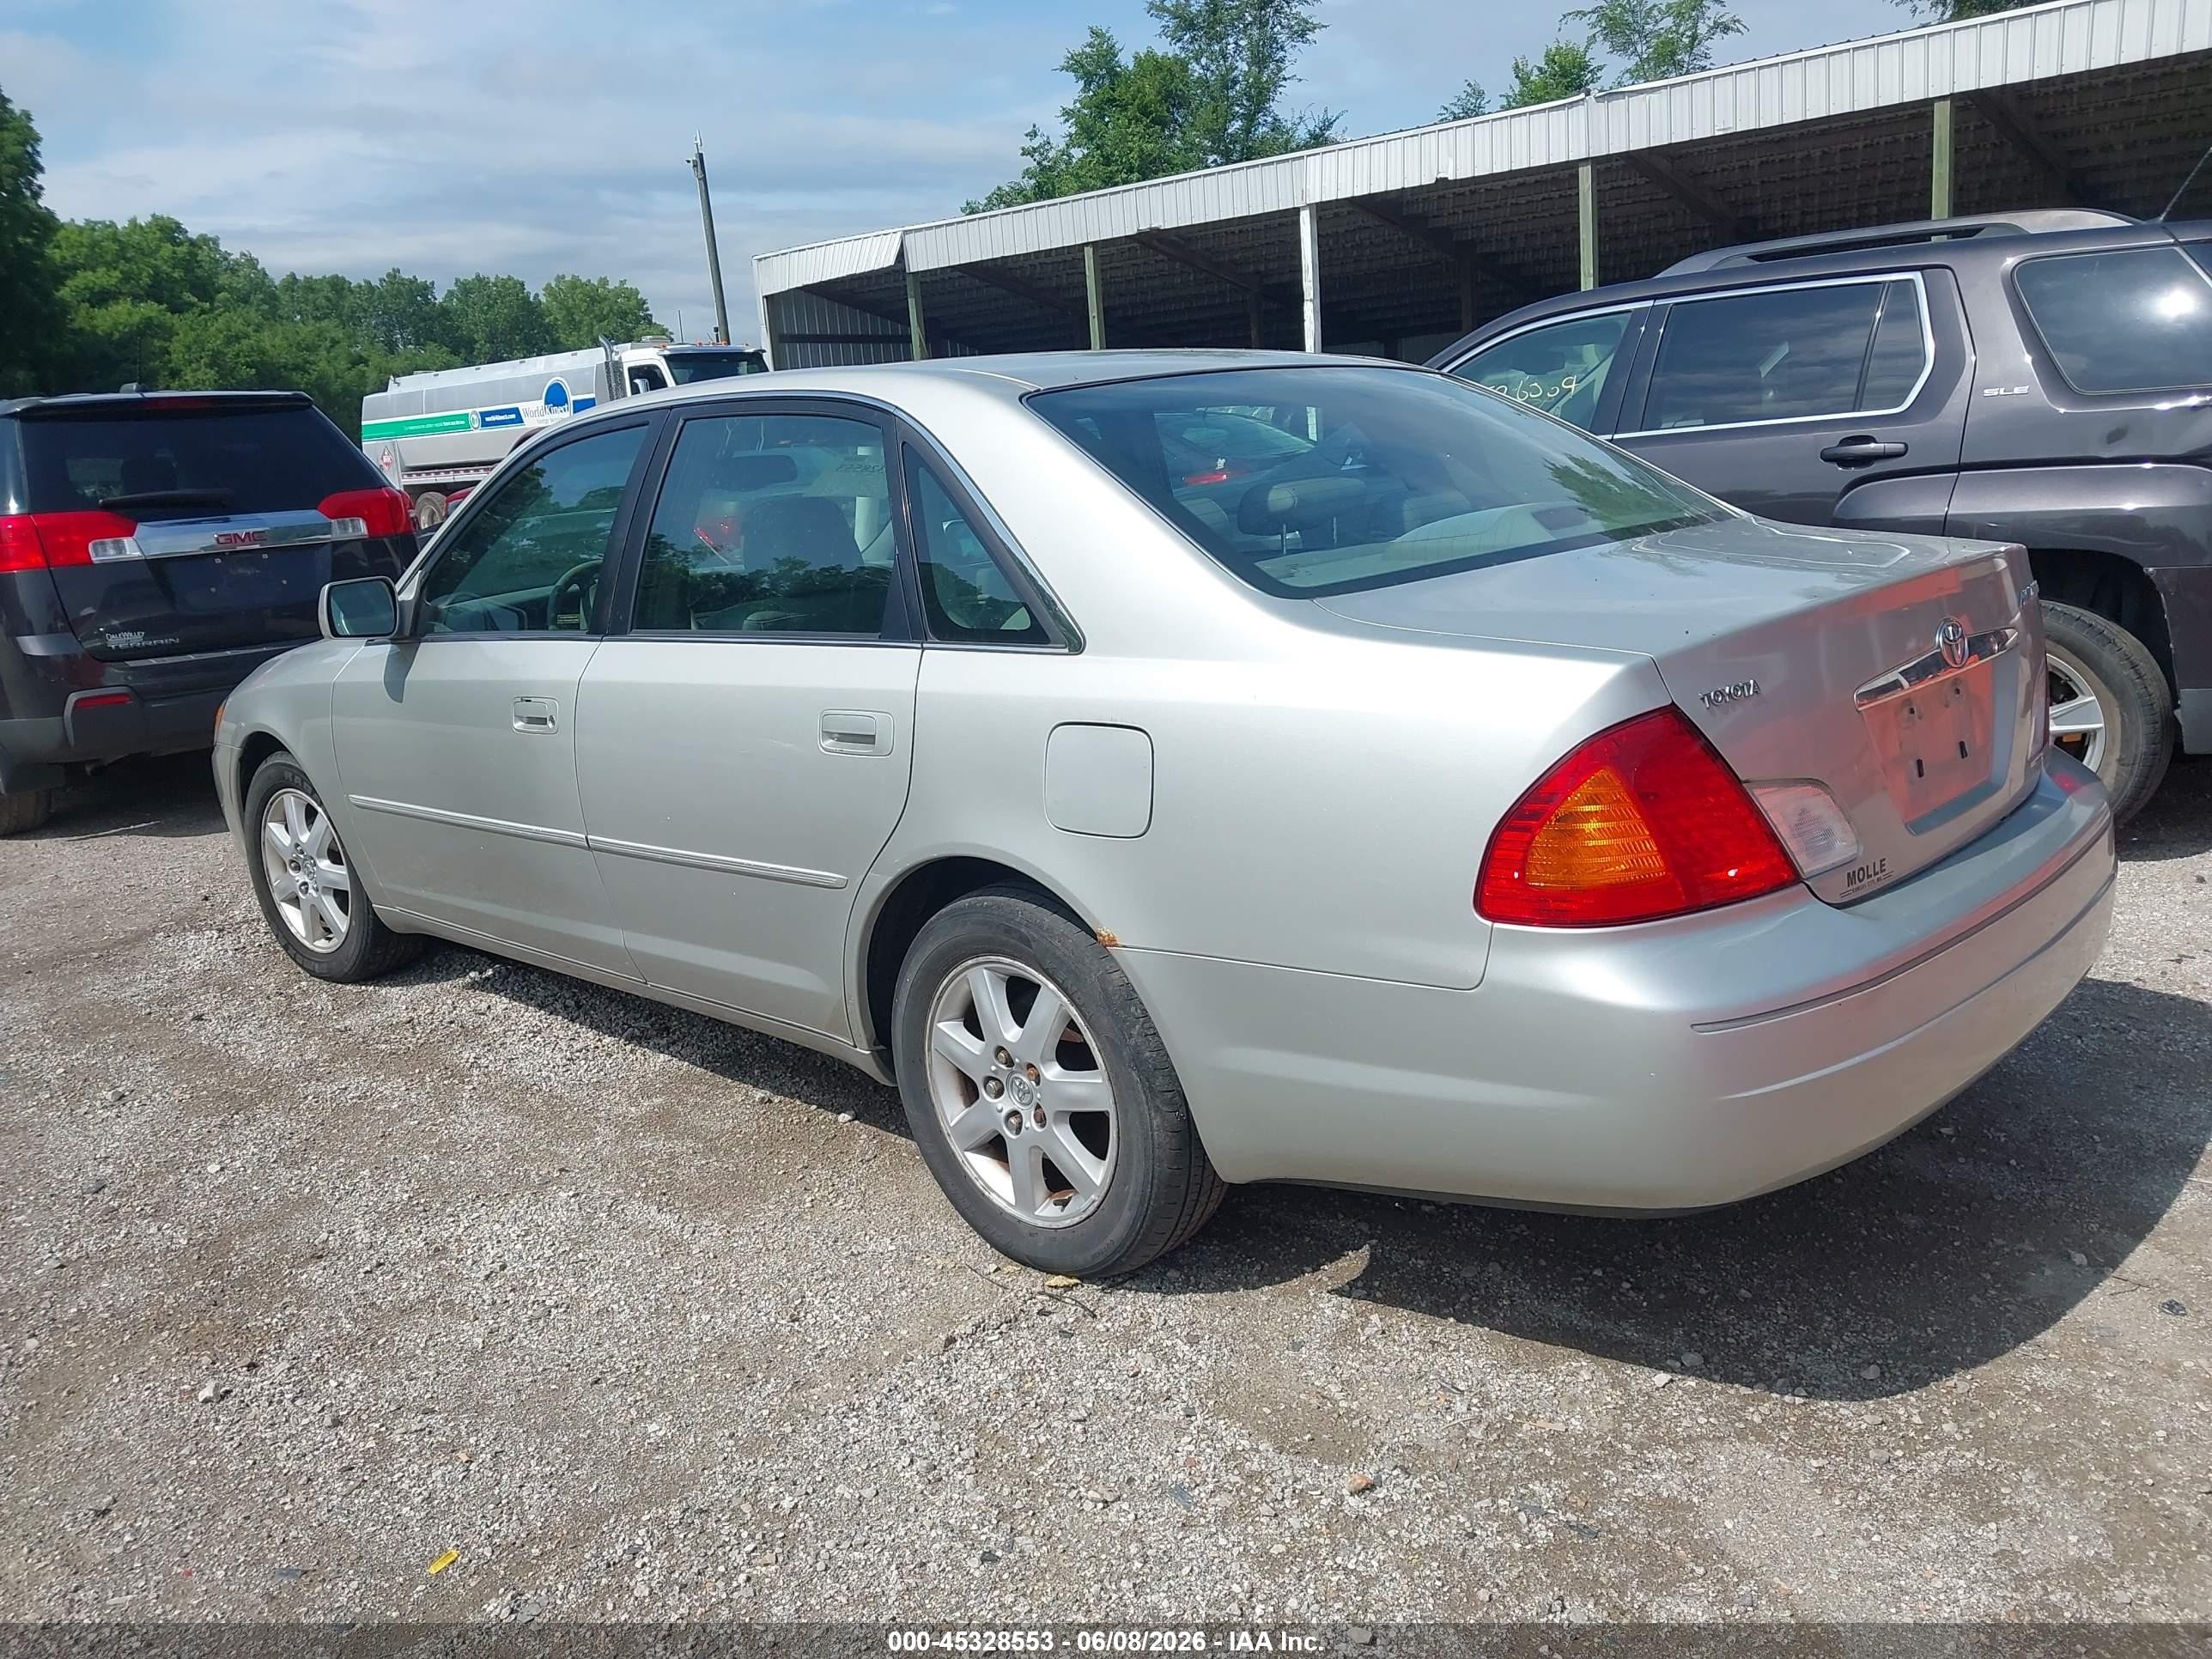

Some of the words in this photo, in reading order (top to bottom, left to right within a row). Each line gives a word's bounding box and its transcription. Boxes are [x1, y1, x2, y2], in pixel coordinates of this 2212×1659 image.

[1984, 386, 2030, 397] SLE
[522, 405, 544, 419] World
[544, 403, 568, 415] Kinect
[213, 530, 267, 545] GMC
[1698, 680, 1760, 708] TOYOTA
[1846, 858, 1887, 888] MOLLE
